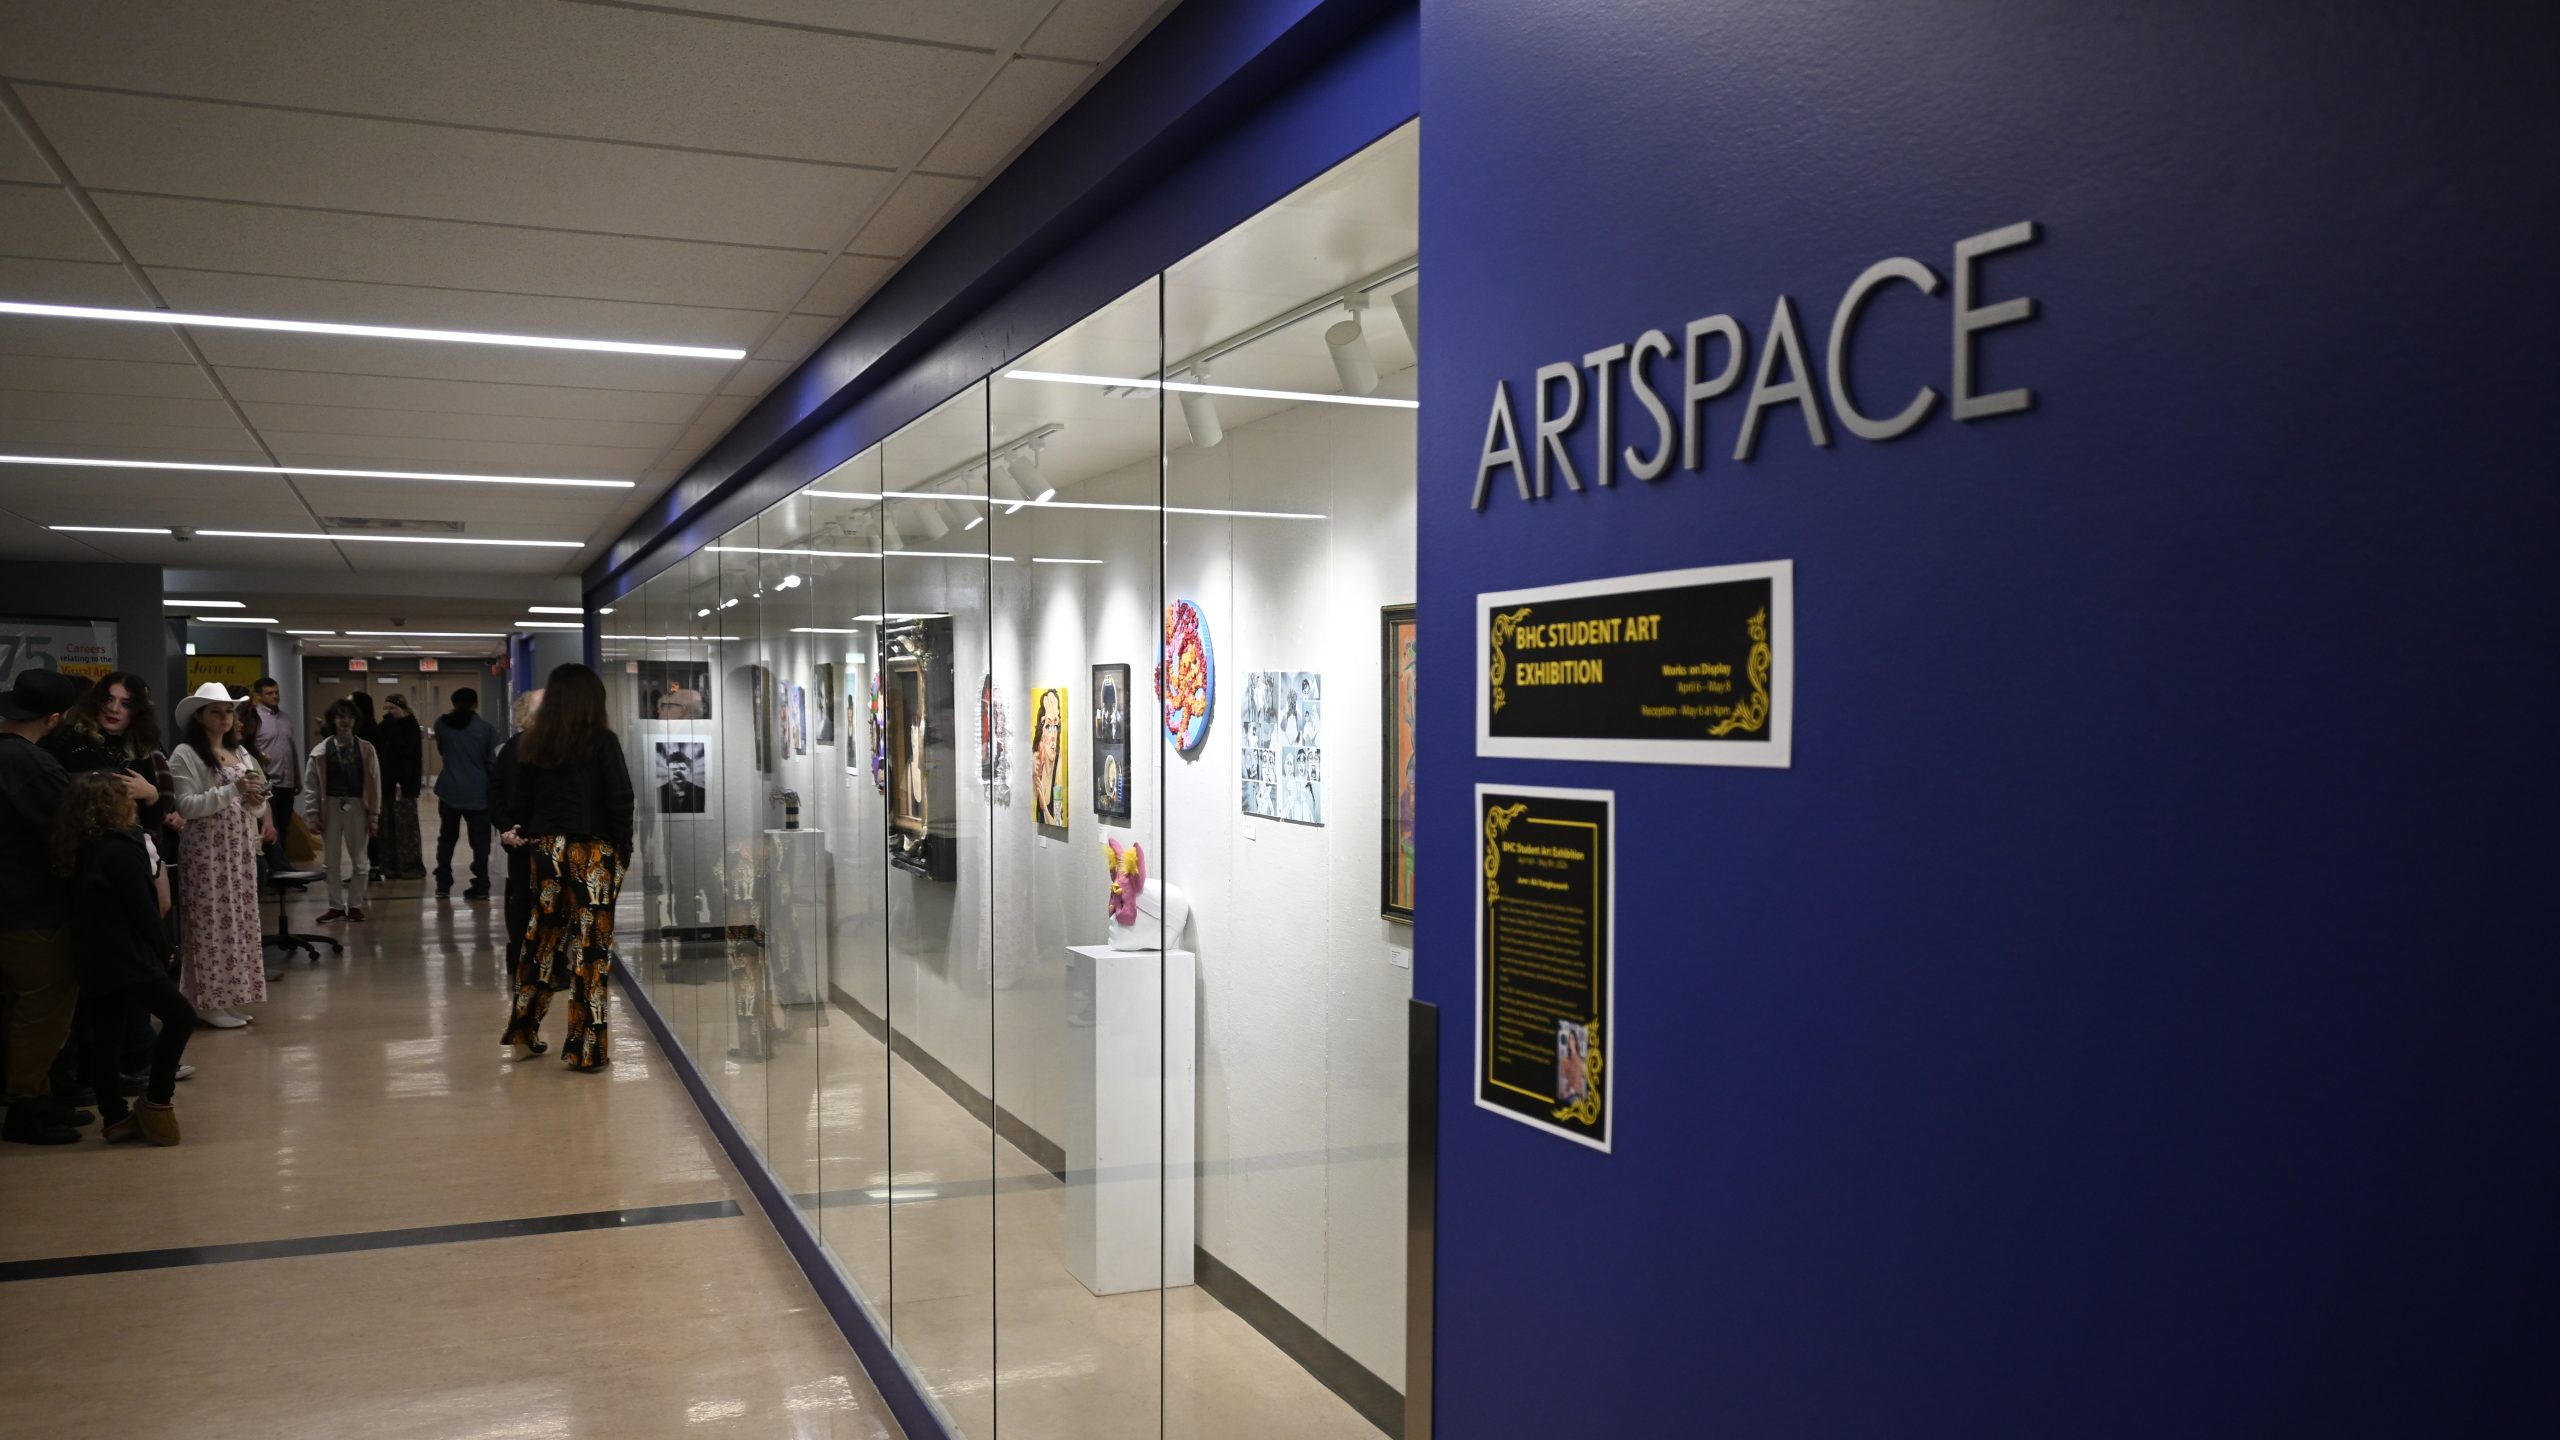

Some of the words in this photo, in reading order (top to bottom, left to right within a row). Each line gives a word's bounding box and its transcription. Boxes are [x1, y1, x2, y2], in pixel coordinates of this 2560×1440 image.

[1471, 220, 2036, 511] ARTSPACE
[1516, 624, 1546, 649] BHC
[1548, 618, 1622, 647] STUDENT
[1624, 615, 1661, 643] ART
[66, 642, 106, 654] Careers
[60, 655, 90, 664] relating
[91, 655, 99, 663] to
[100, 655, 112, 663] the
[190, 660, 222, 674] Join
[226, 664, 236, 674] a
[1516, 659, 1603, 686] EXHIBITION
[1661, 664, 1687, 676] Works
[1690, 665, 1701, 675] on
[1701, 662, 1731, 677] Display
[1677, 681, 1695, 694] April
[1708, 681, 1725, 693] May
[1641, 704, 1677, 718] Reception
[1682, 705, 1699, 719] May
[1517, 843, 1540, 856] Student
[1552, 847, 1585, 861] Exhibition
